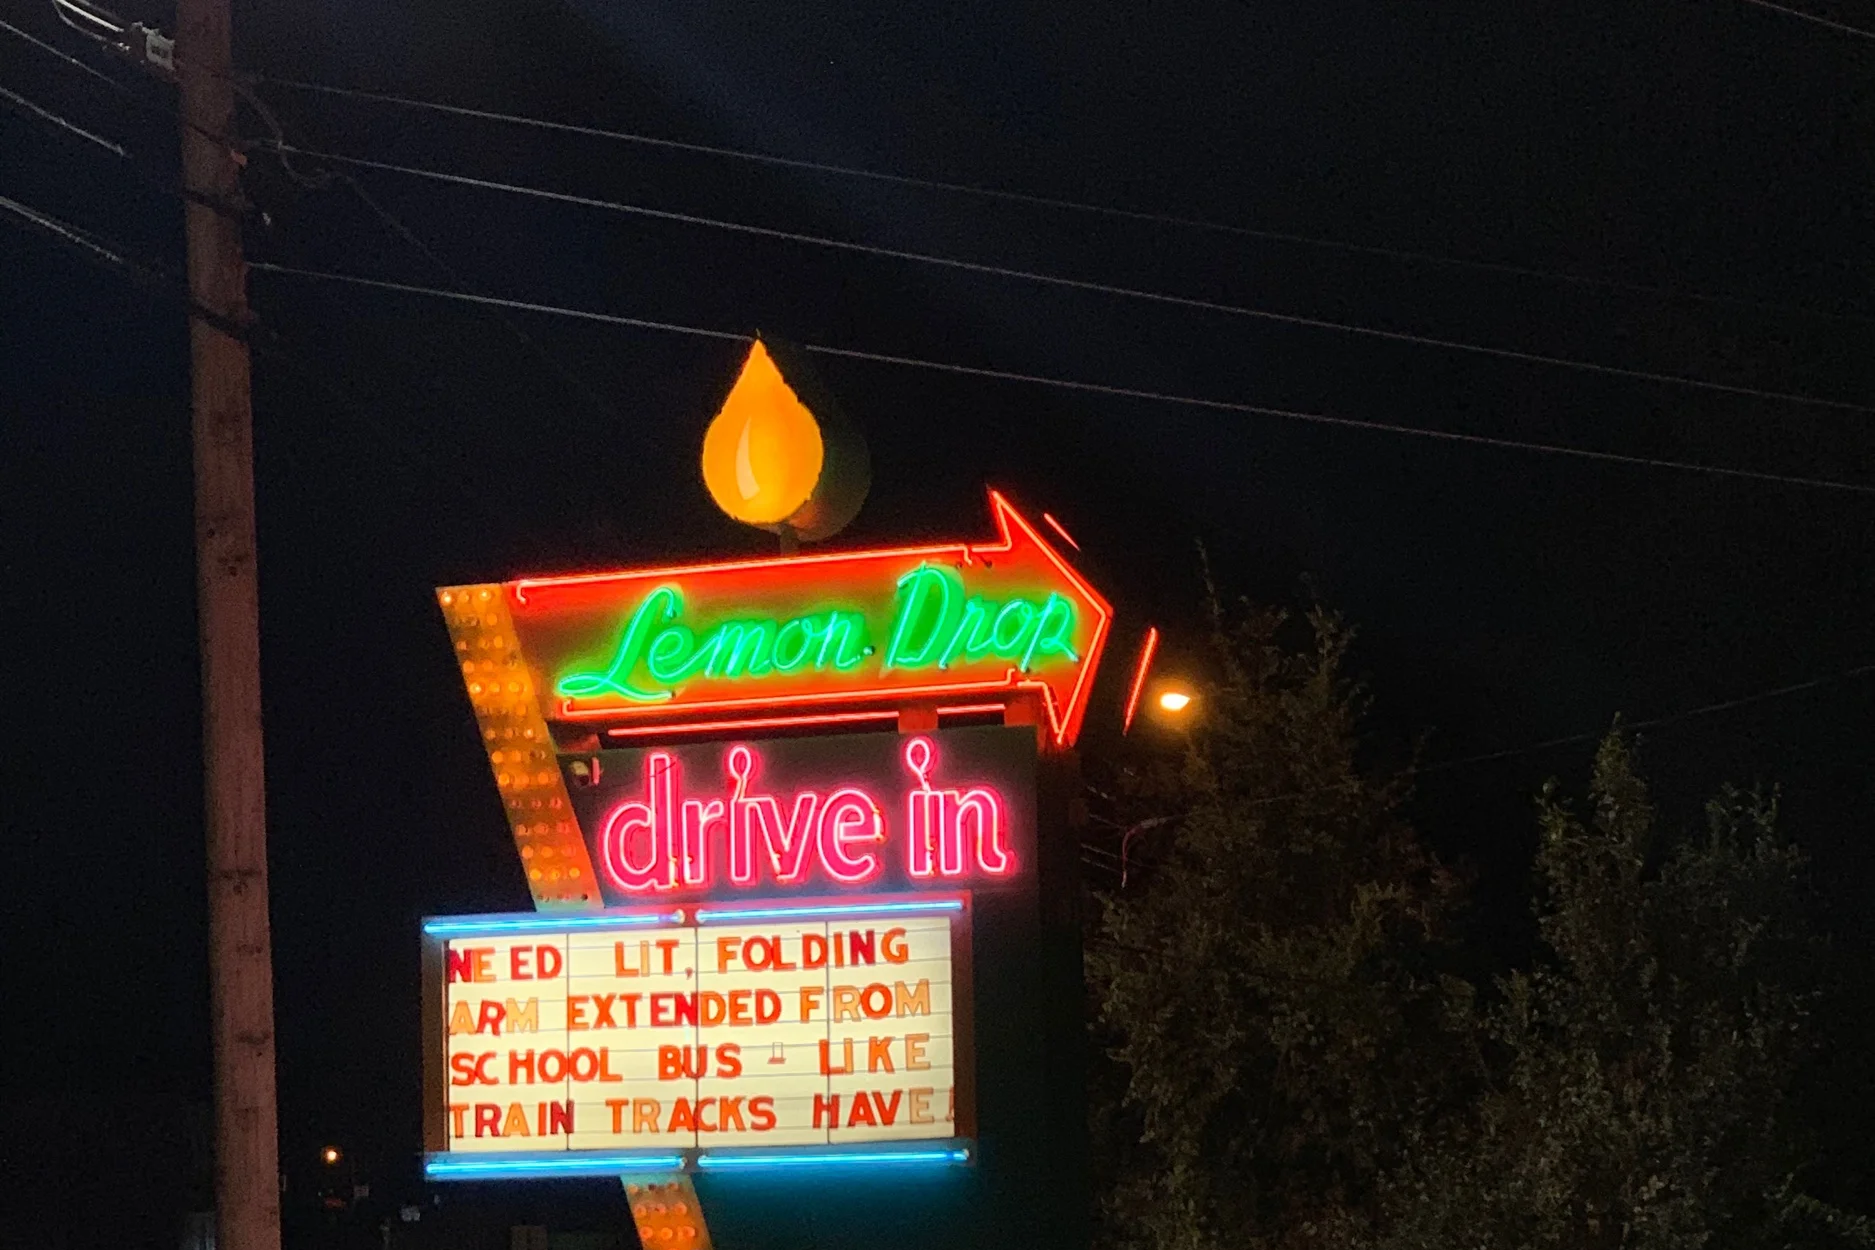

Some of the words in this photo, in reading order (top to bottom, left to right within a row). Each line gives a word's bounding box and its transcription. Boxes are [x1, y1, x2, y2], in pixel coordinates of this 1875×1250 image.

[557, 583, 868, 702] Lemon
[881, 561, 1080, 674] Drop
[602, 743, 887, 891] drive
[903, 736, 1014, 878] in
[447, 943, 563, 983] NEED
[614, 939, 694, 980] LIT,
[716, 927, 910, 974] FOLDING
[449, 997, 539, 1036] ARM
[567, 989, 782, 1031] EXTENDED
[799, 978, 931, 1024] FROM
[451, 1046, 623, 1086] SCHOOL
[658, 1043, 743, 1080] BUS
[818, 1033, 932, 1077] LIKE
[448, 1099, 574, 1139] TRAIN
[605, 1095, 778, 1135] TRACKS
